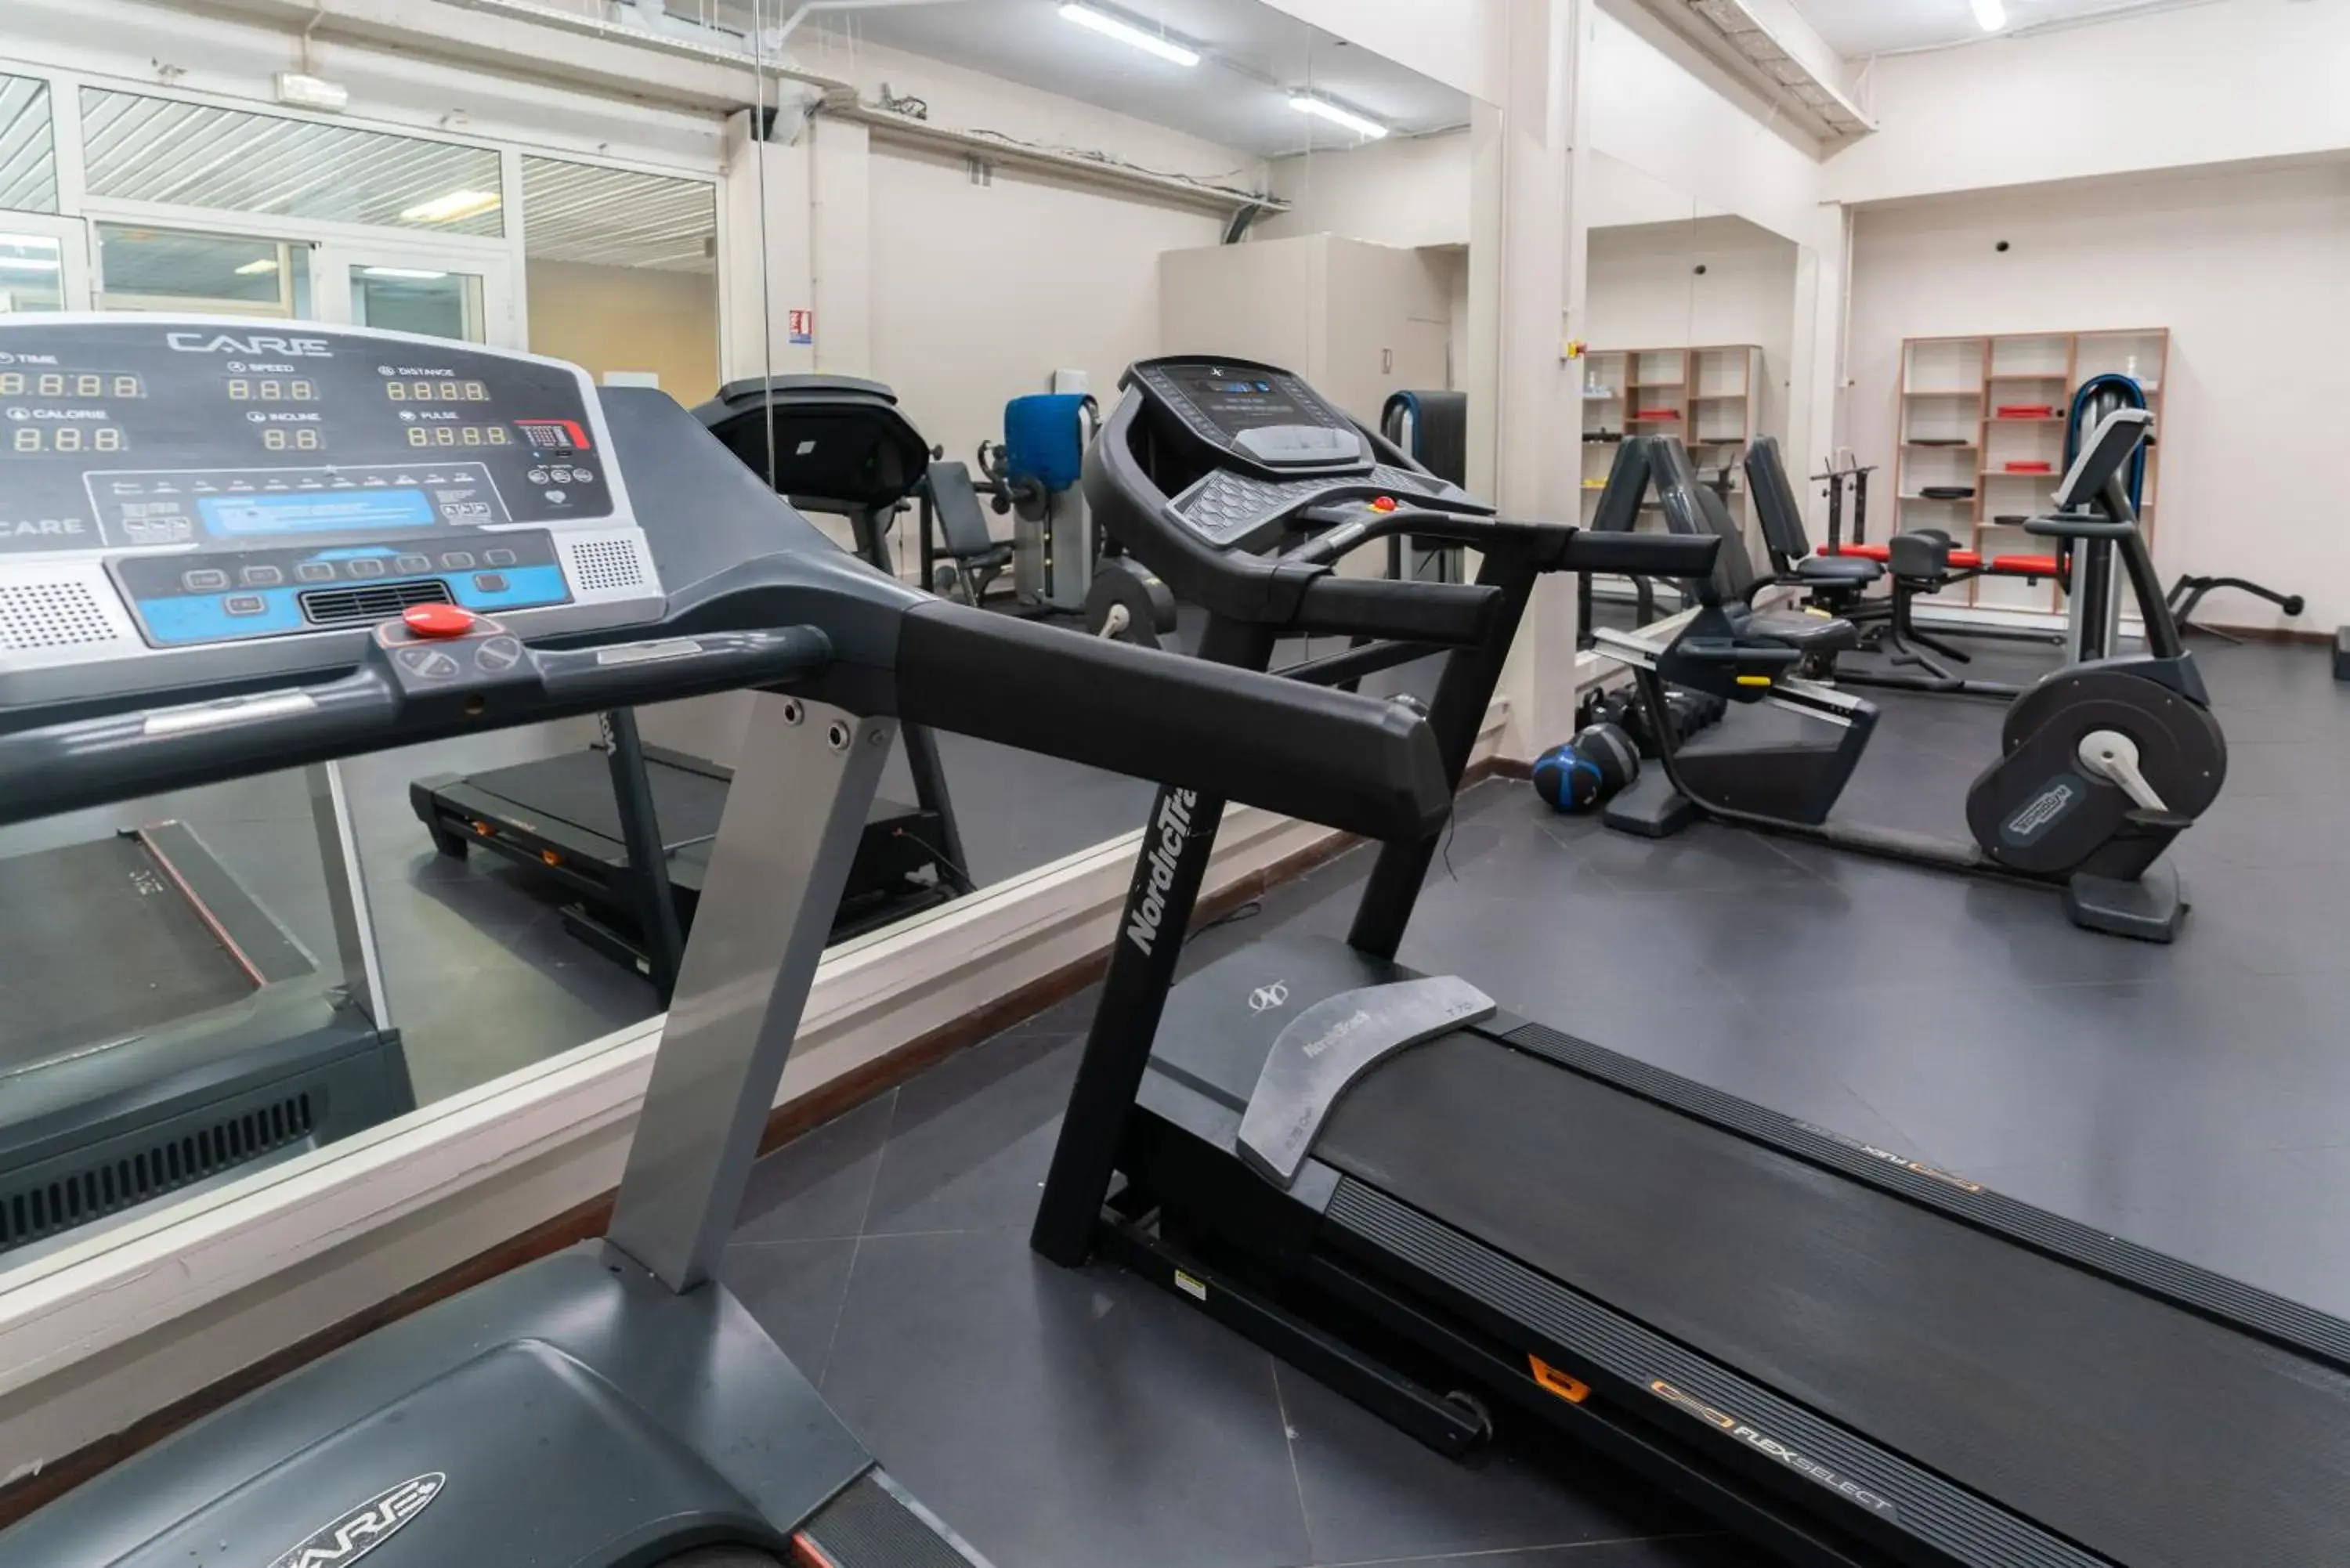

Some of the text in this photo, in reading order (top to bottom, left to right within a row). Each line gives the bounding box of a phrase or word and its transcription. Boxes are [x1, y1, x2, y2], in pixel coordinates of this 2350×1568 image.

[167, 332, 333, 357] CARE
[16, 354, 59, 364] TIME
[248, 363, 295, 372] SPEED
[397, 368, 456, 377] DISTANCE
[32, 409, 109, 420] CALORIE
[268, 413, 322, 421] INCLINE
[1126, 786, 1198, 957] NordicTra
[288, 1481, 428, 1568] ARE
